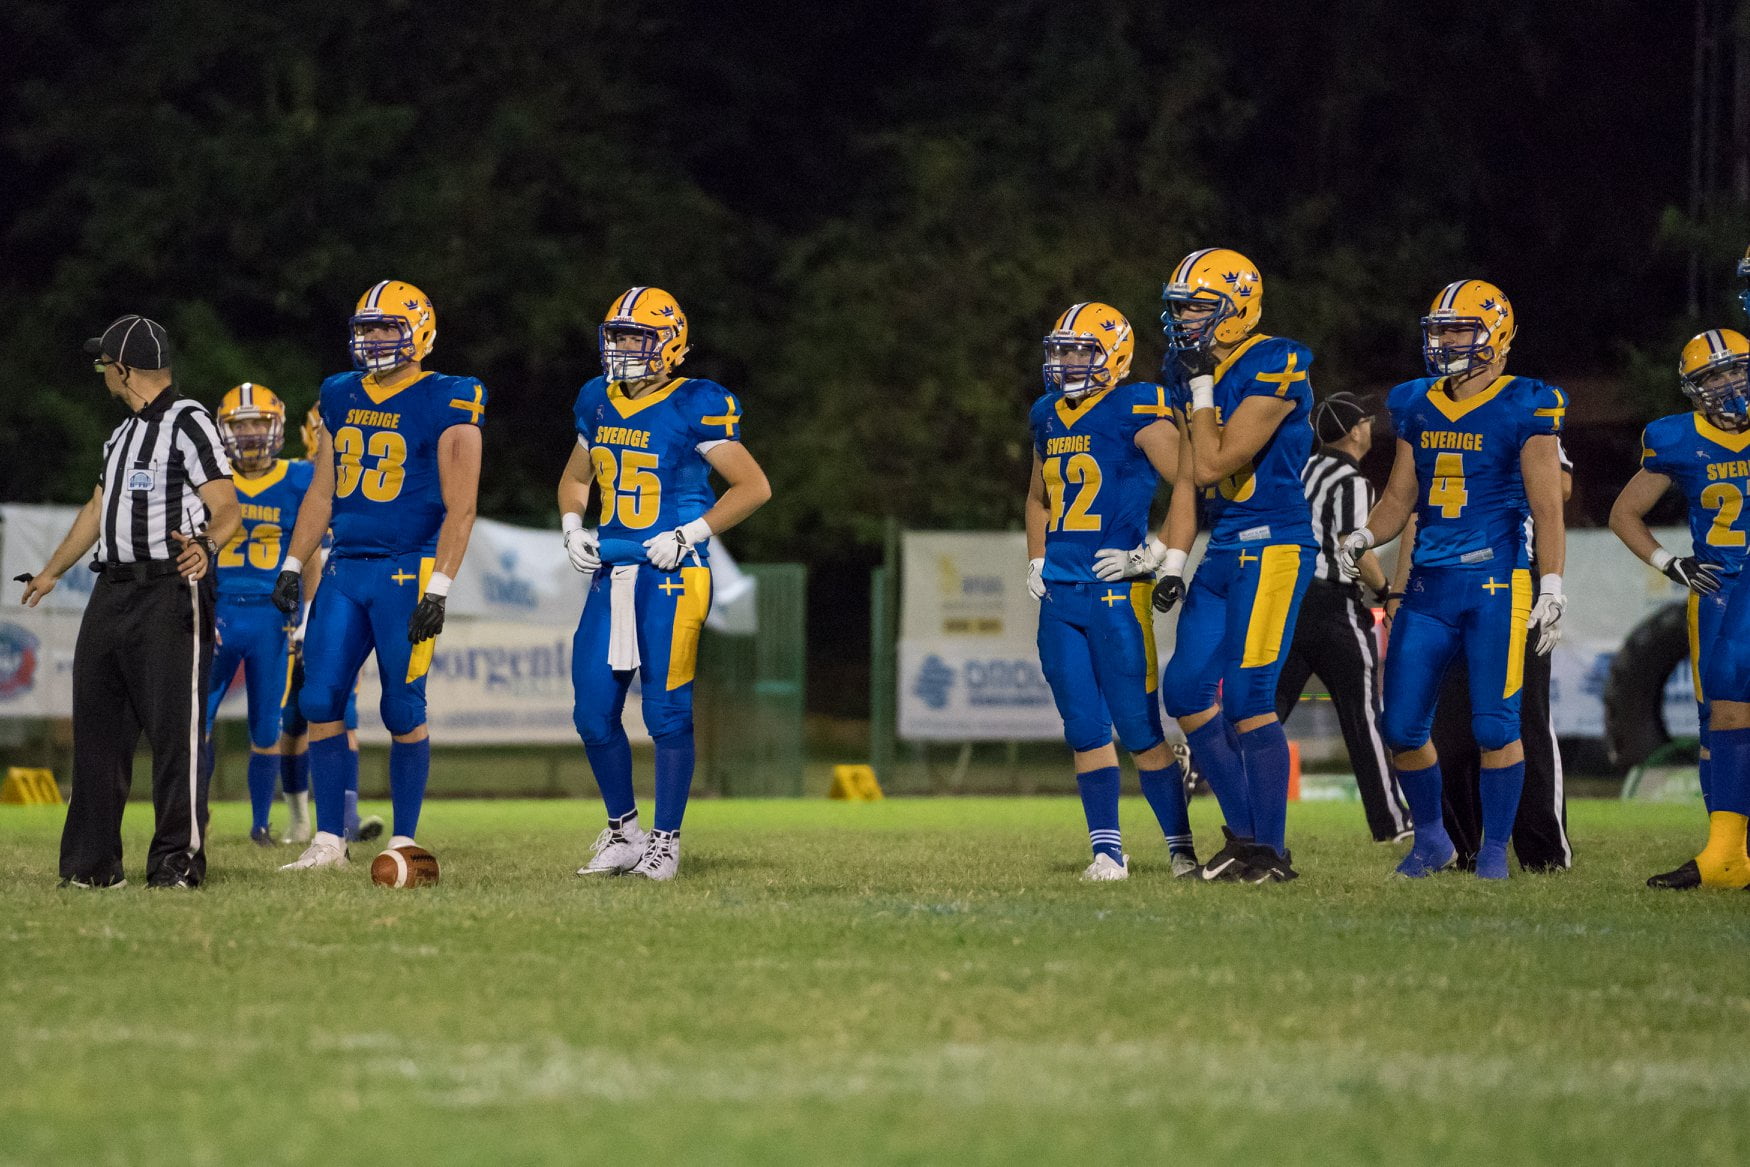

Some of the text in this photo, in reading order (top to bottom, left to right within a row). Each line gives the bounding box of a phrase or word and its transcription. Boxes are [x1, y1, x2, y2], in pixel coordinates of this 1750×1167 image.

[345, 408, 401, 429] SVERIGE
[595, 426, 651, 449] SVERIGE
[1046, 434, 1092, 456] SVERIGE
[1421, 431, 1484, 452] SVERIGE
[334, 426, 408, 503] 33
[589, 446, 662, 530] 85
[1042, 452, 1103, 533] 42
[1428, 452, 1469, 519] 4
[239, 503, 281, 523] ERIGE
